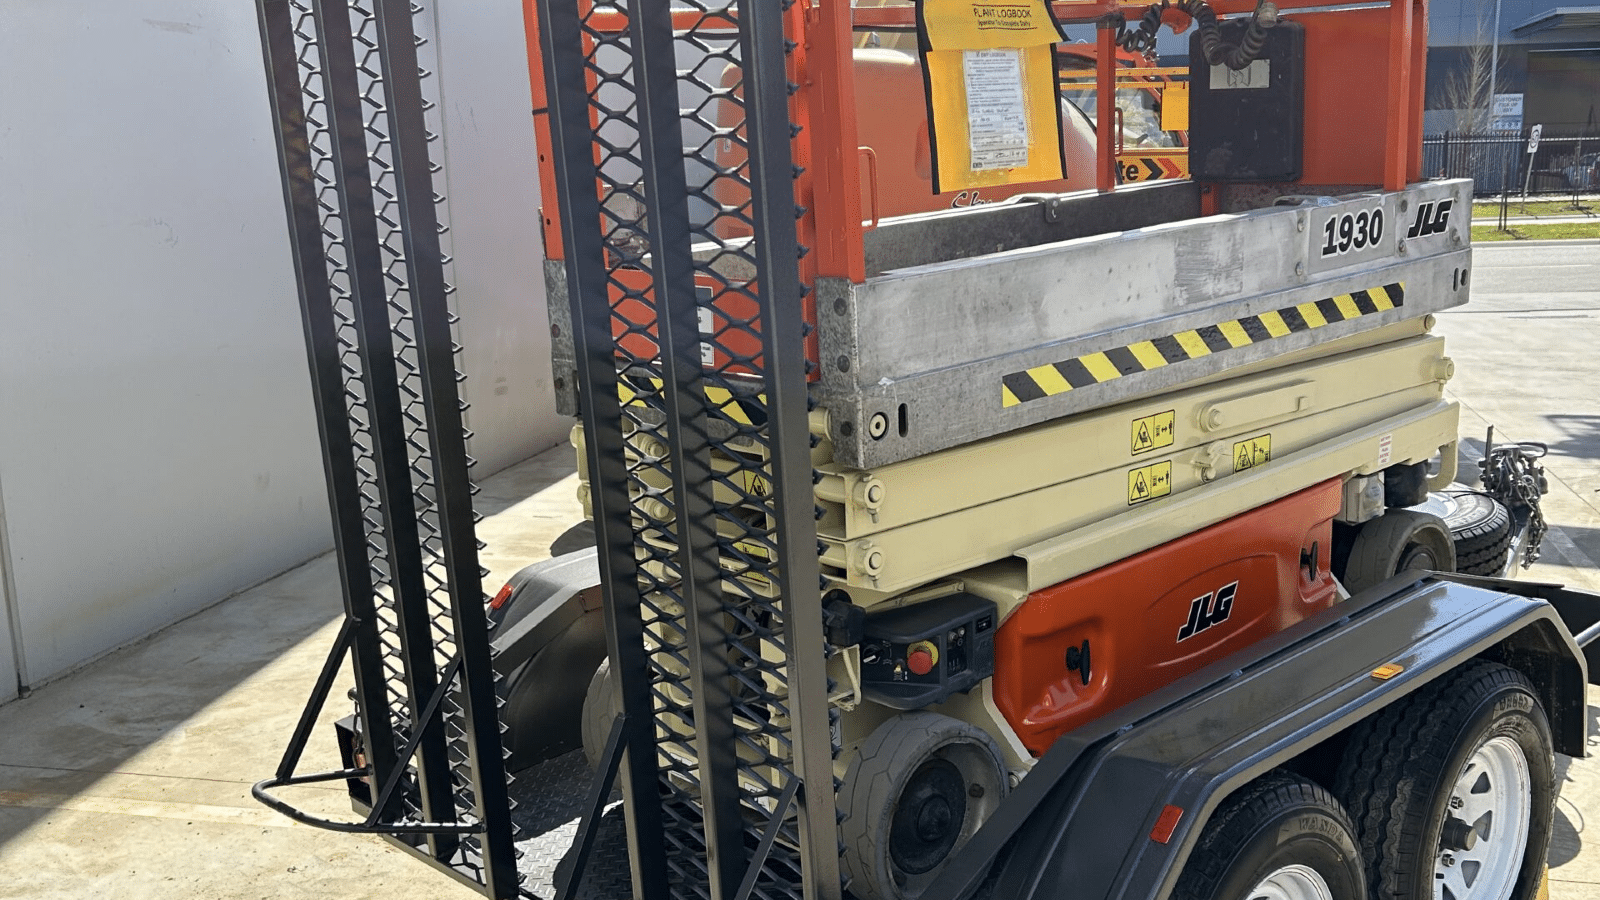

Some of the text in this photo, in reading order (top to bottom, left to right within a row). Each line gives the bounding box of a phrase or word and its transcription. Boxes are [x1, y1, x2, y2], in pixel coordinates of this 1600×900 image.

[973, 8, 1032, 18] PLANT LOGBOOK
[1322, 208, 1384, 256] 1930
[1407, 200, 1453, 239] JLG
[1177, 581, 1238, 643] JLG
[1298, 816, 1344, 845] WANDA
